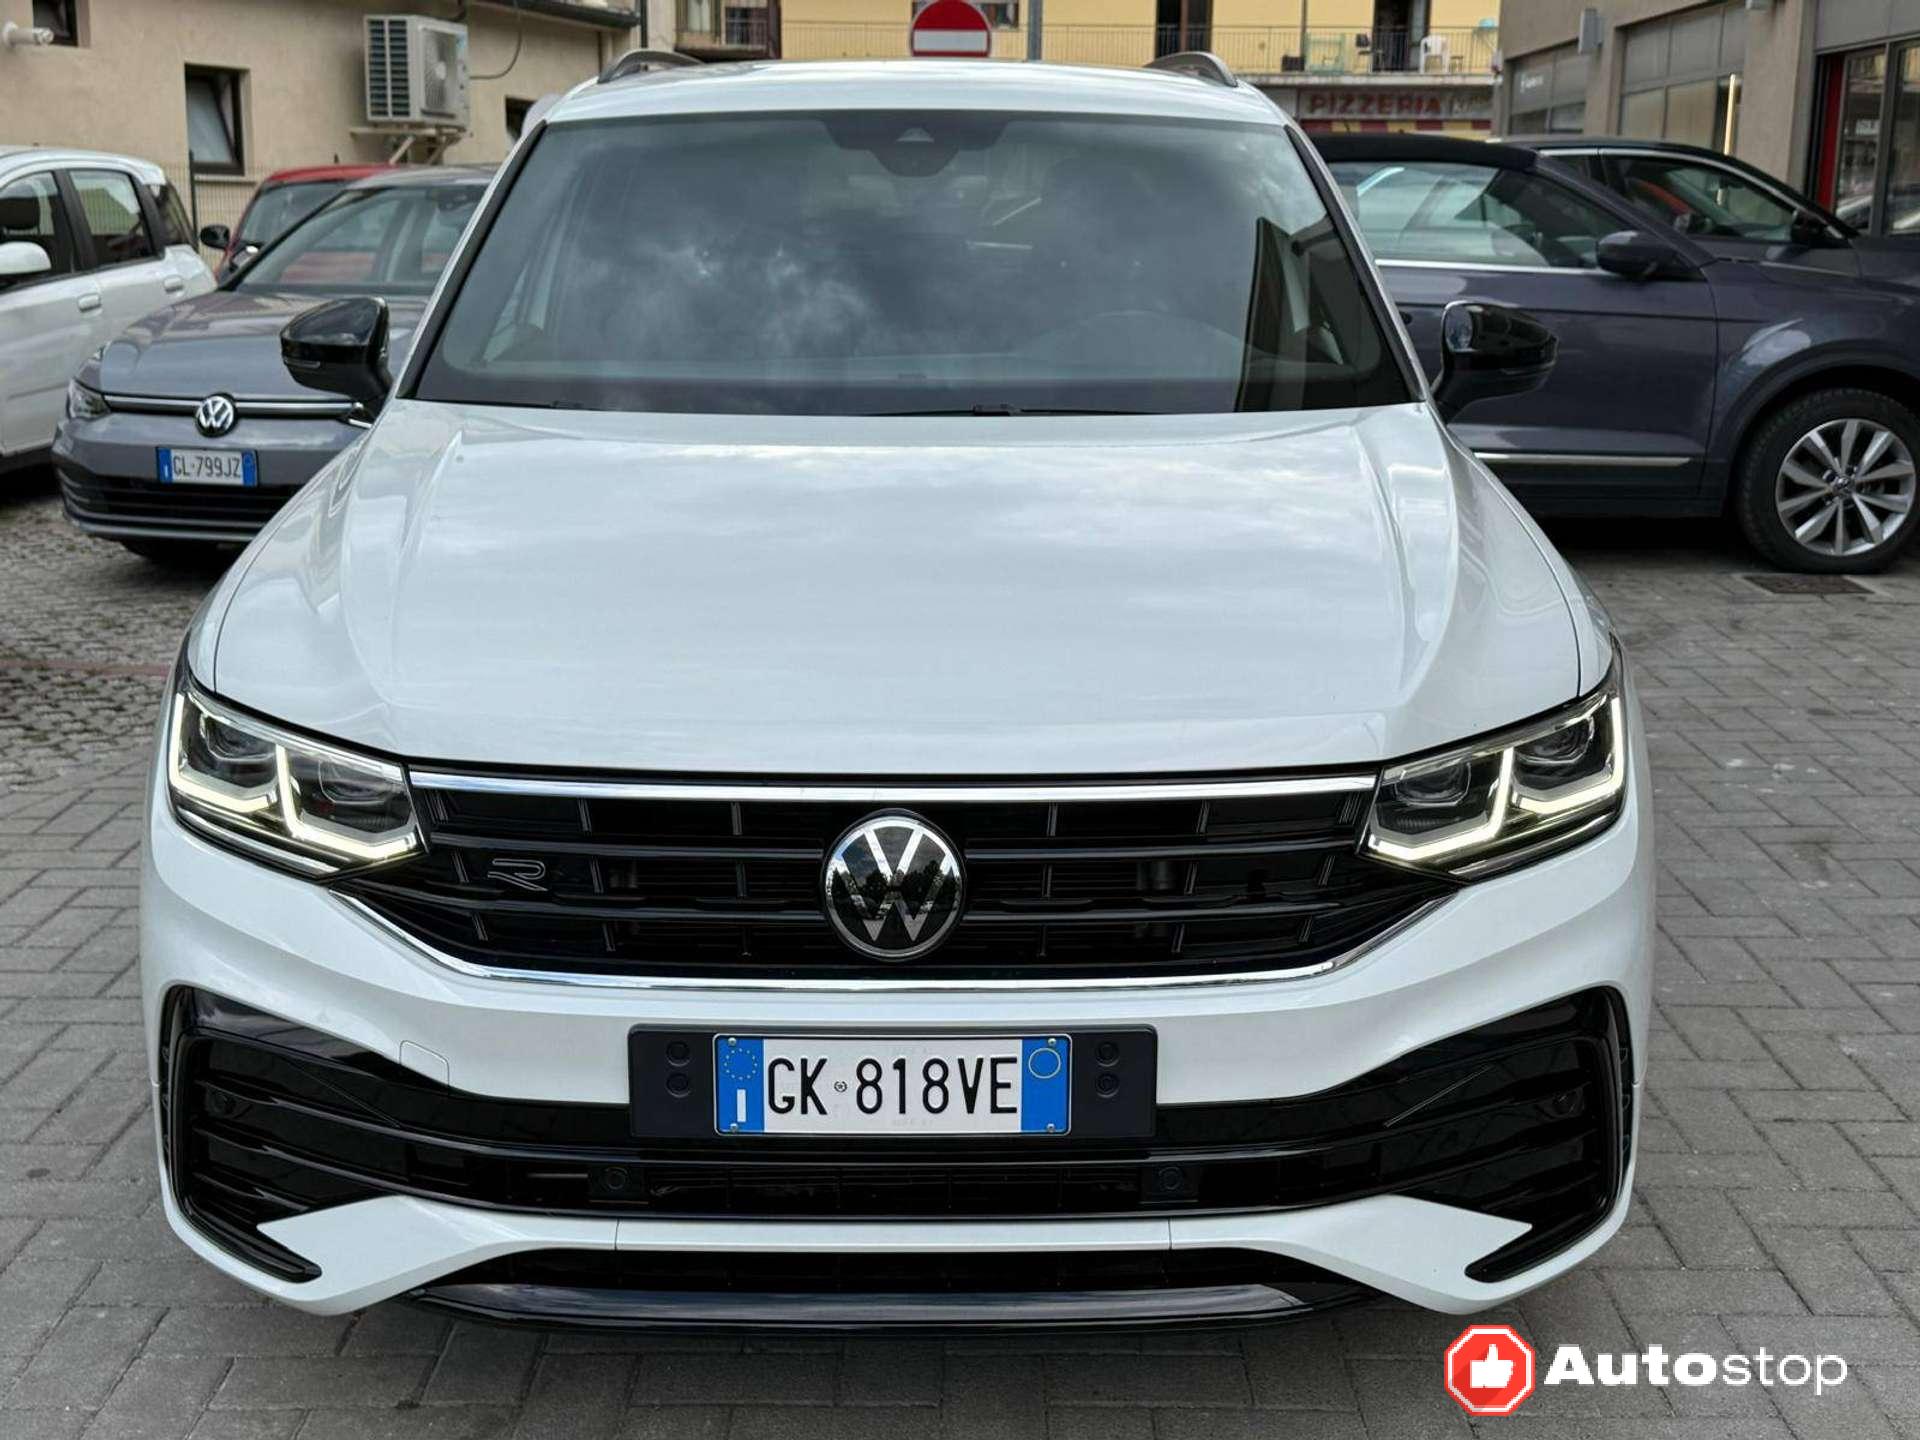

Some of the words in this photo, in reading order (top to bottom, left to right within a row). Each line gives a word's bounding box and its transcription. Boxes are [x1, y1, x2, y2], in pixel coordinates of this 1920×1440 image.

[1309, 93, 1441, 115] PIZZERIA
[196, 456, 241, 478] 799JZ
[827, 816, 960, 957] VW
[767, 1057, 828, 1115] GK
[856, 1057, 1018, 1115] 818VE
